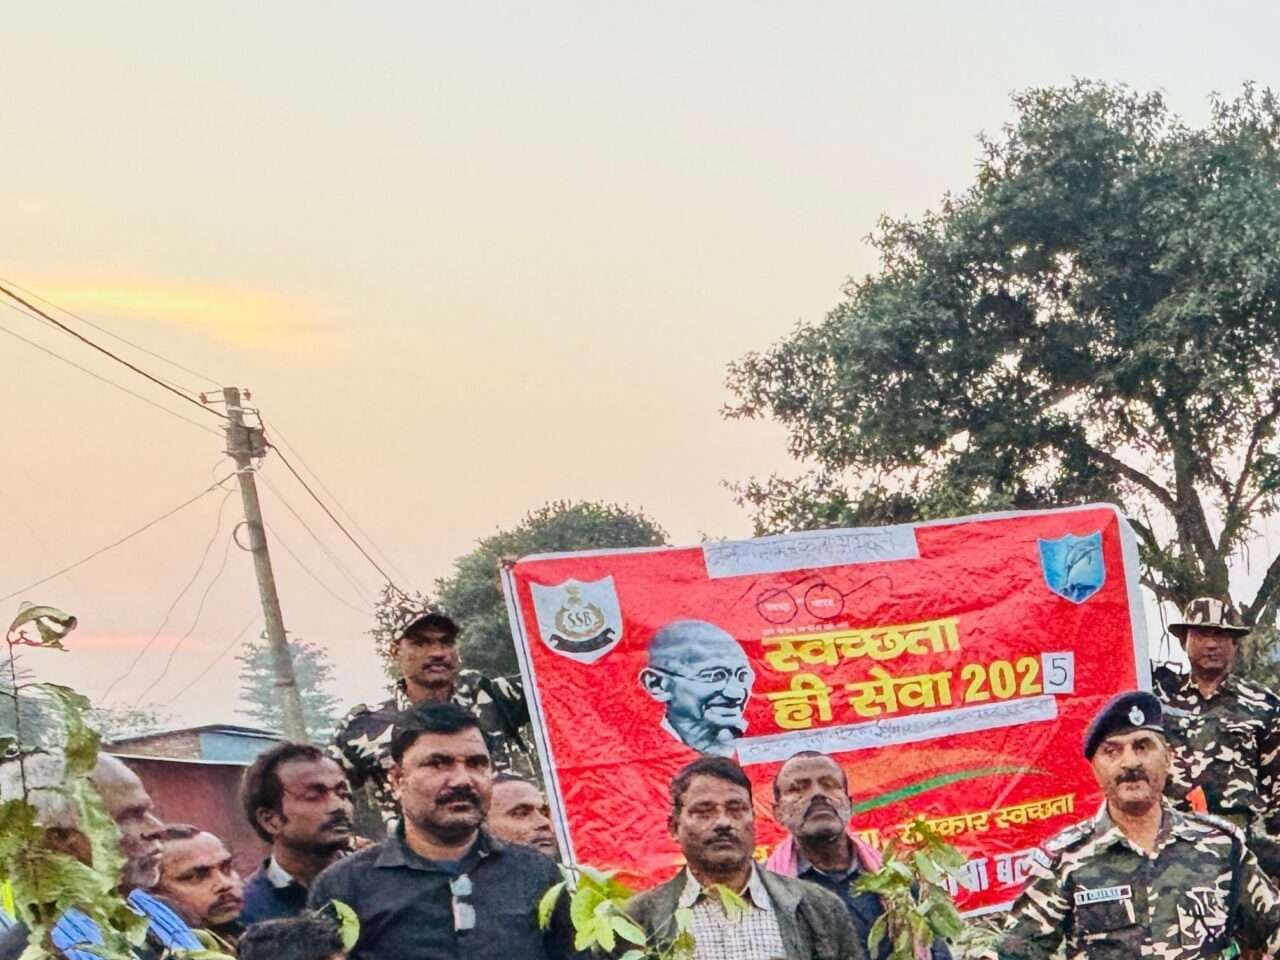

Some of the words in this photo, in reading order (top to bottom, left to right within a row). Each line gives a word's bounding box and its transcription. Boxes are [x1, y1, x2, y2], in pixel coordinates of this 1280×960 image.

[567, 610, 592, 627] SSB
[761, 616, 961, 672] स्वच्छता
[767, 672, 834, 730] ही
[845, 666, 953, 718] सेवा
[994, 792, 1077, 829] स्वच्छता
